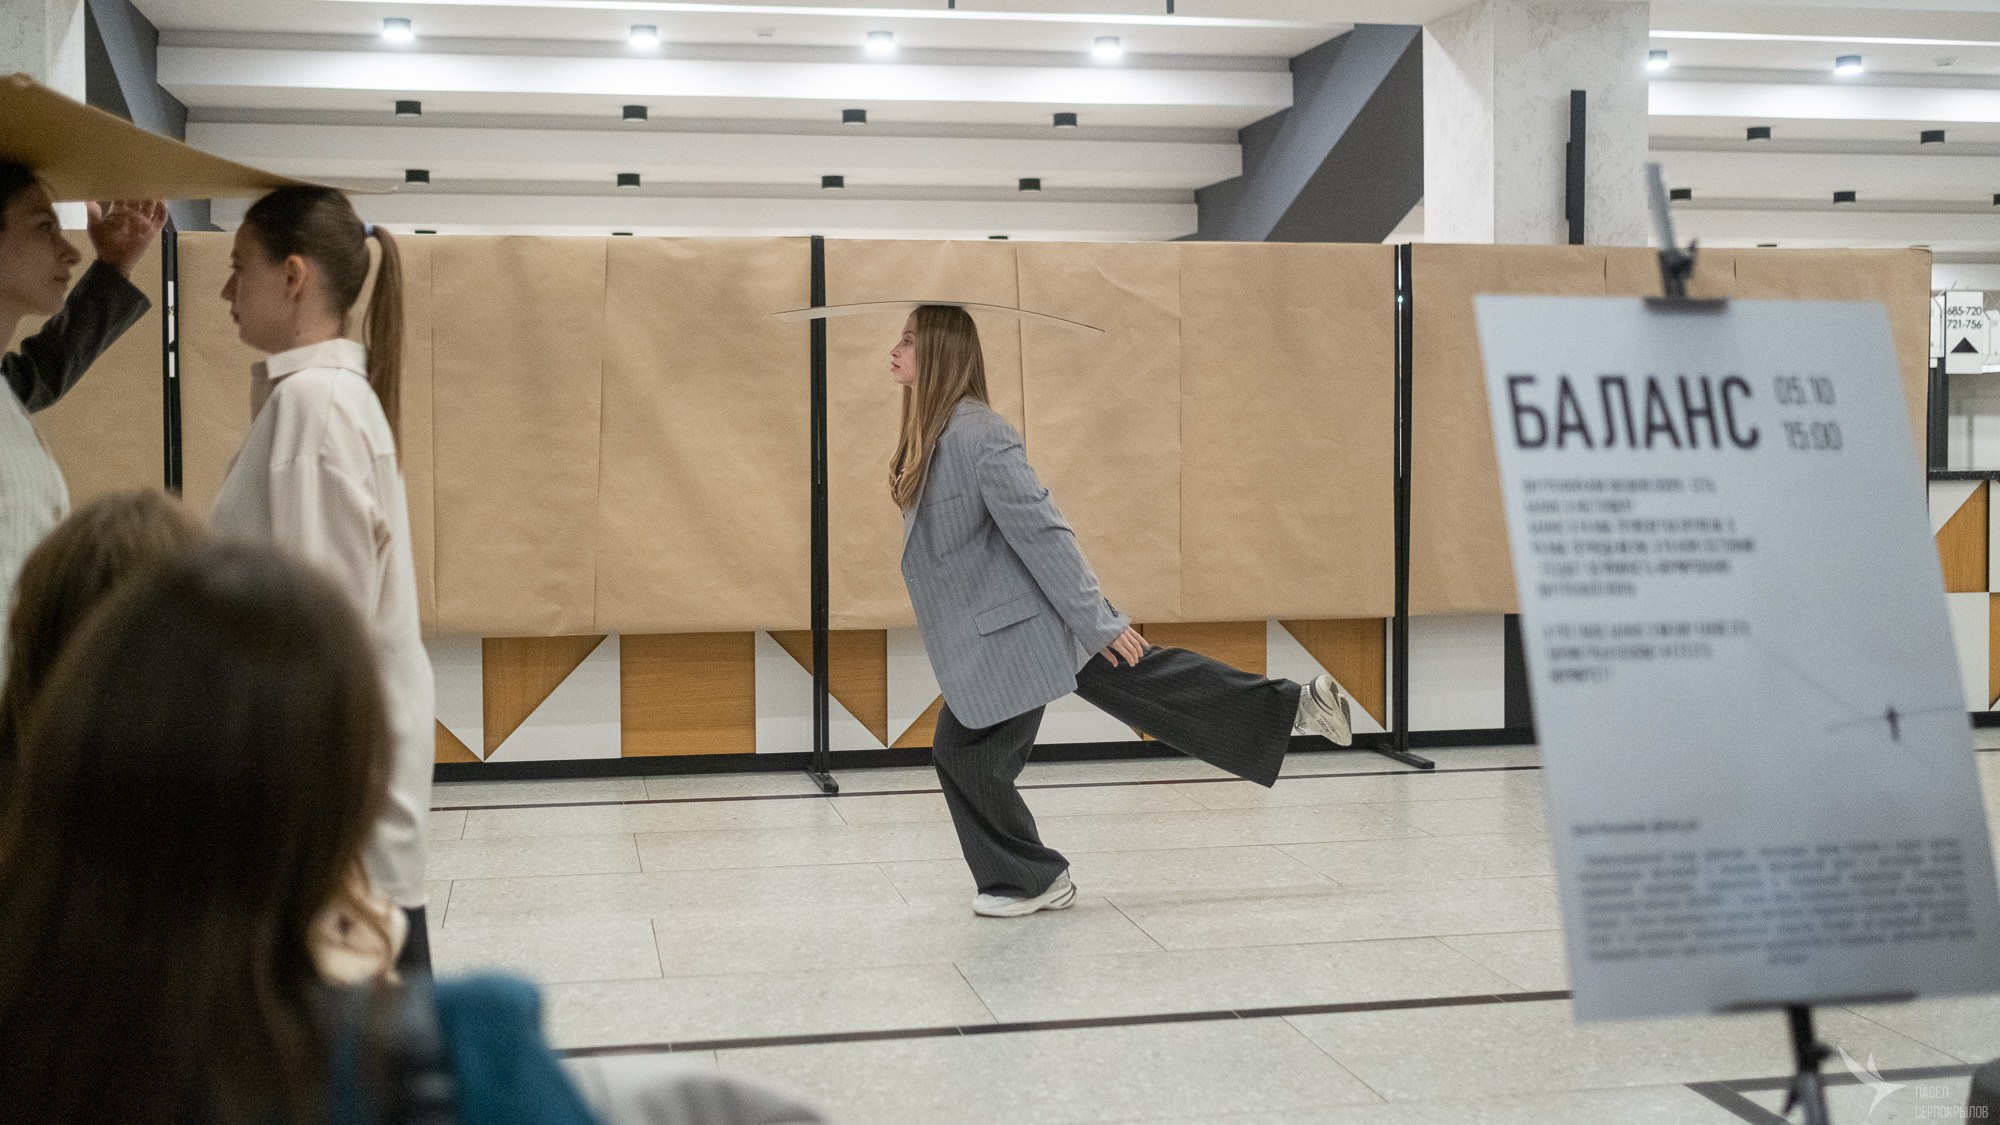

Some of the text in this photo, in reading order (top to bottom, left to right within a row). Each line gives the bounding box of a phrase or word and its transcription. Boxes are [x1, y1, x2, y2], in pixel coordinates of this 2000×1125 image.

[1947, 306, 1982, 316] 685-720
[1947, 319, 1982, 329] 721-756
[1506, 374, 1760, 451] БАЛАНС
